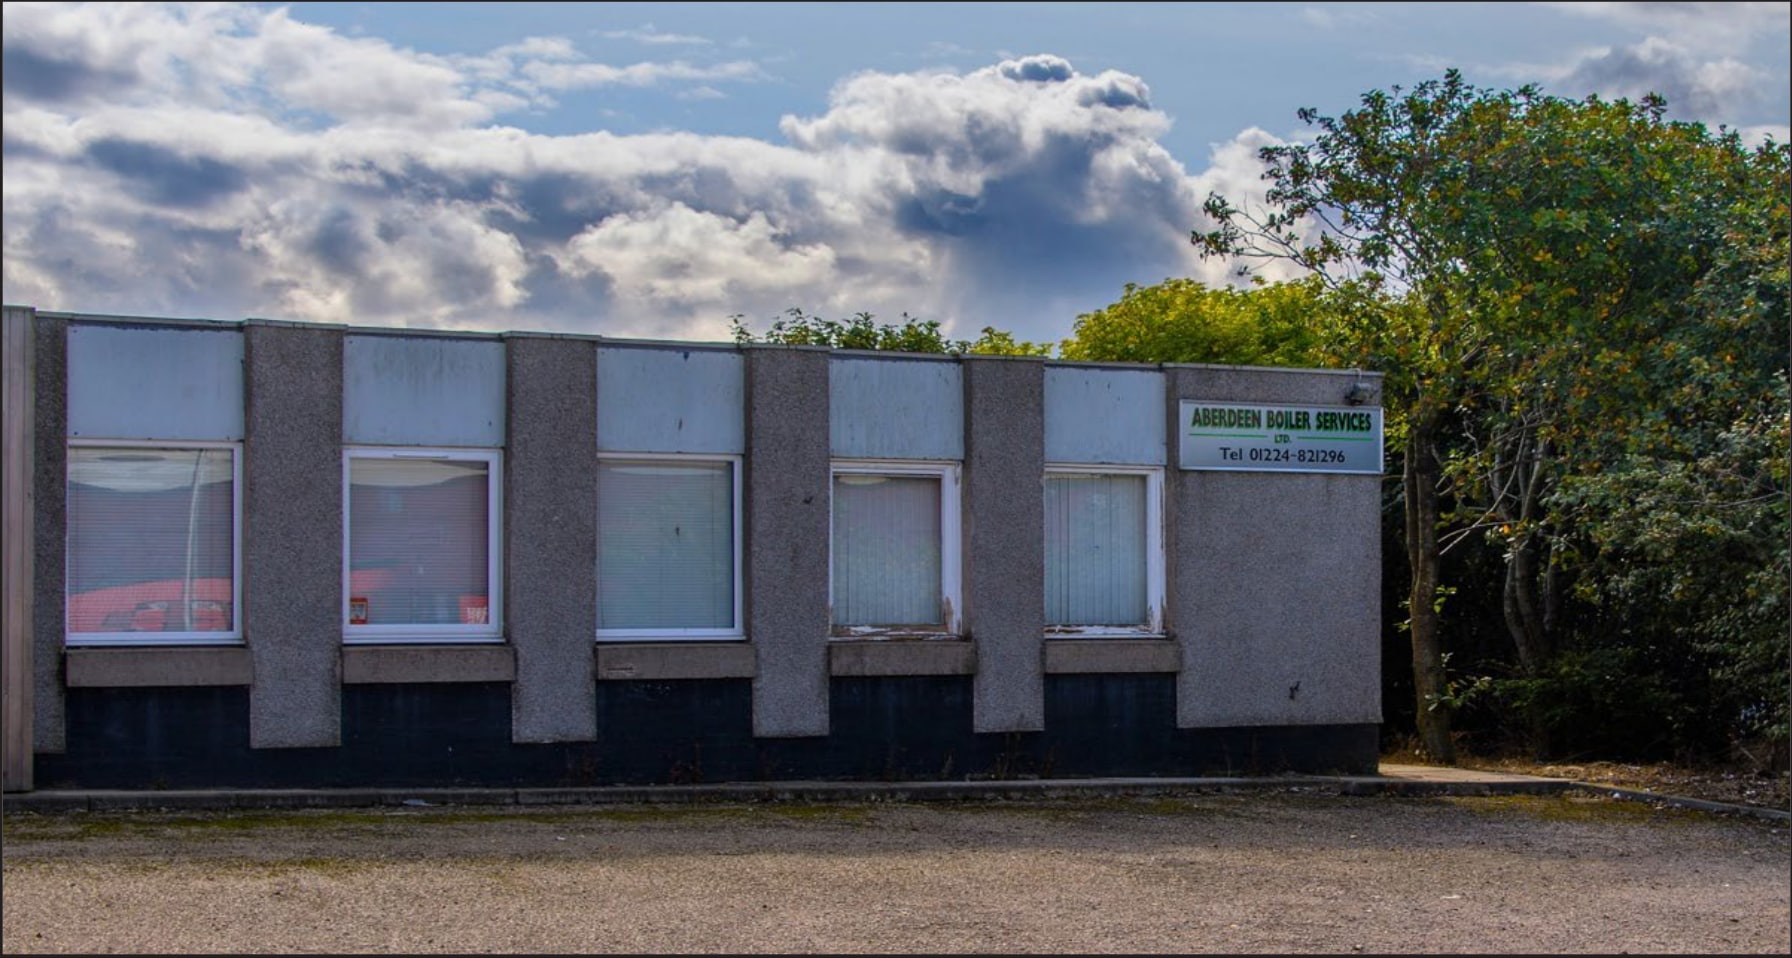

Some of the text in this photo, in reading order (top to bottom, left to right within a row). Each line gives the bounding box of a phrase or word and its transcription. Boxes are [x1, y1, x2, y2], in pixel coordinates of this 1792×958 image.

[1192, 407, 1372, 432] ABERDEEN BOILER SERVICES
[1219, 447, 1346, 463] Tel 01224-821296
